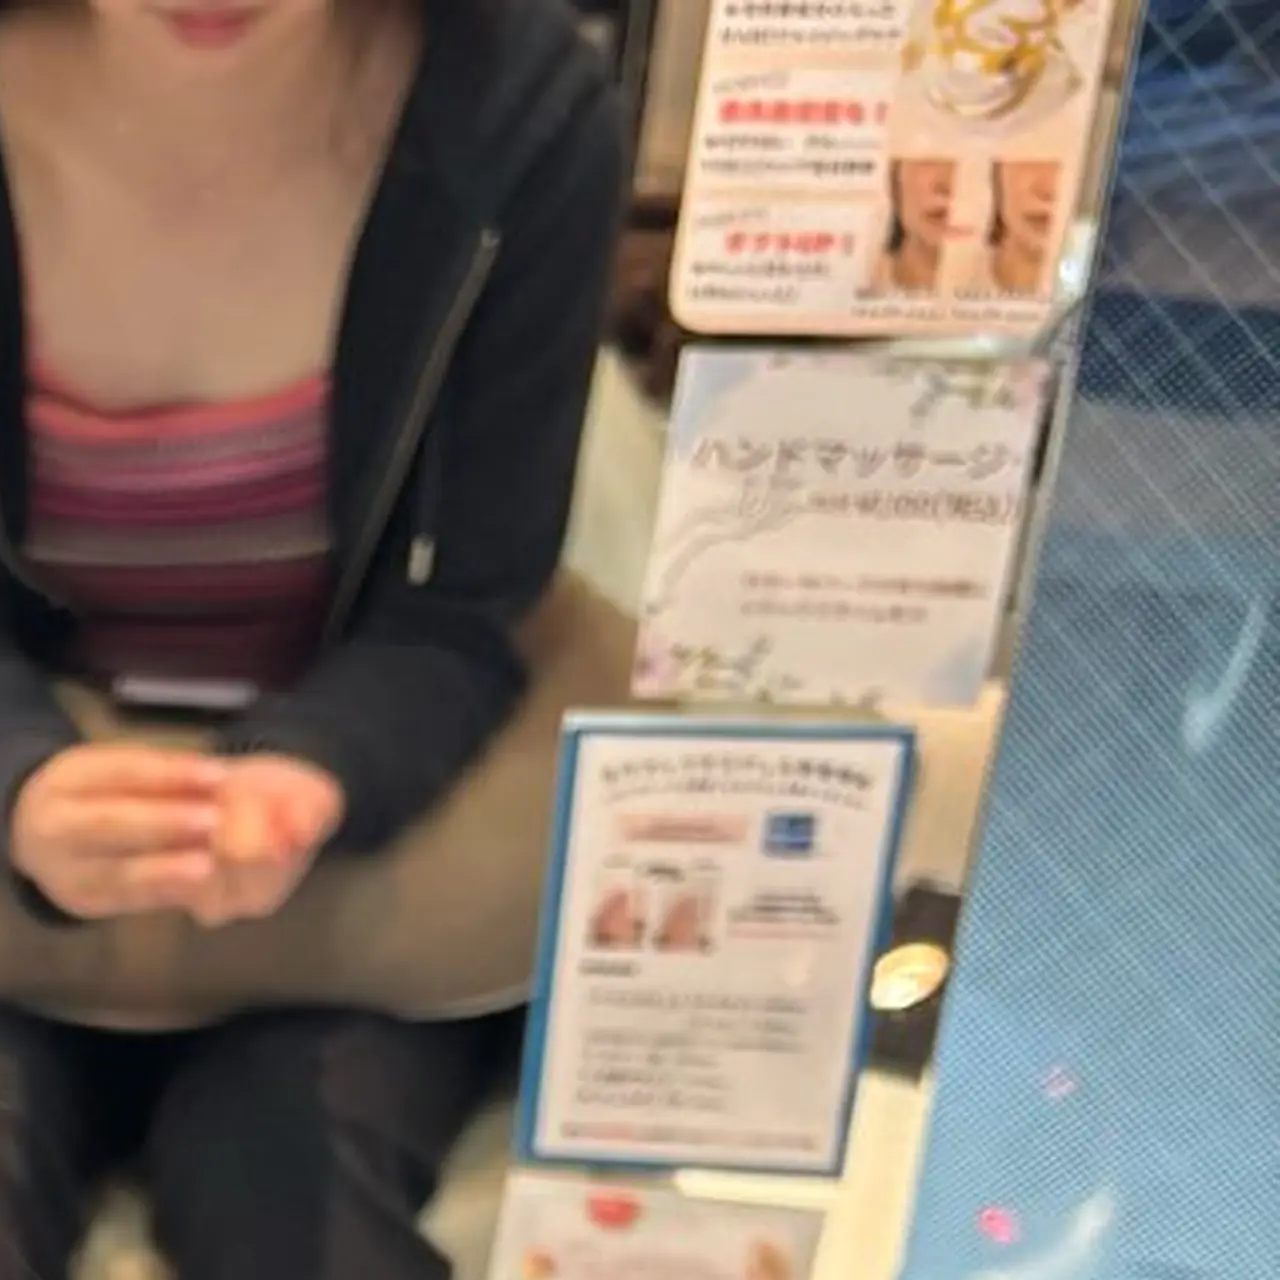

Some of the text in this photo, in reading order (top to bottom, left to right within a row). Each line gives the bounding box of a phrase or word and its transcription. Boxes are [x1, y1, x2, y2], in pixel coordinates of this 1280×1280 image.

[690, 438, 1009, 479] ハンドマッサージ
